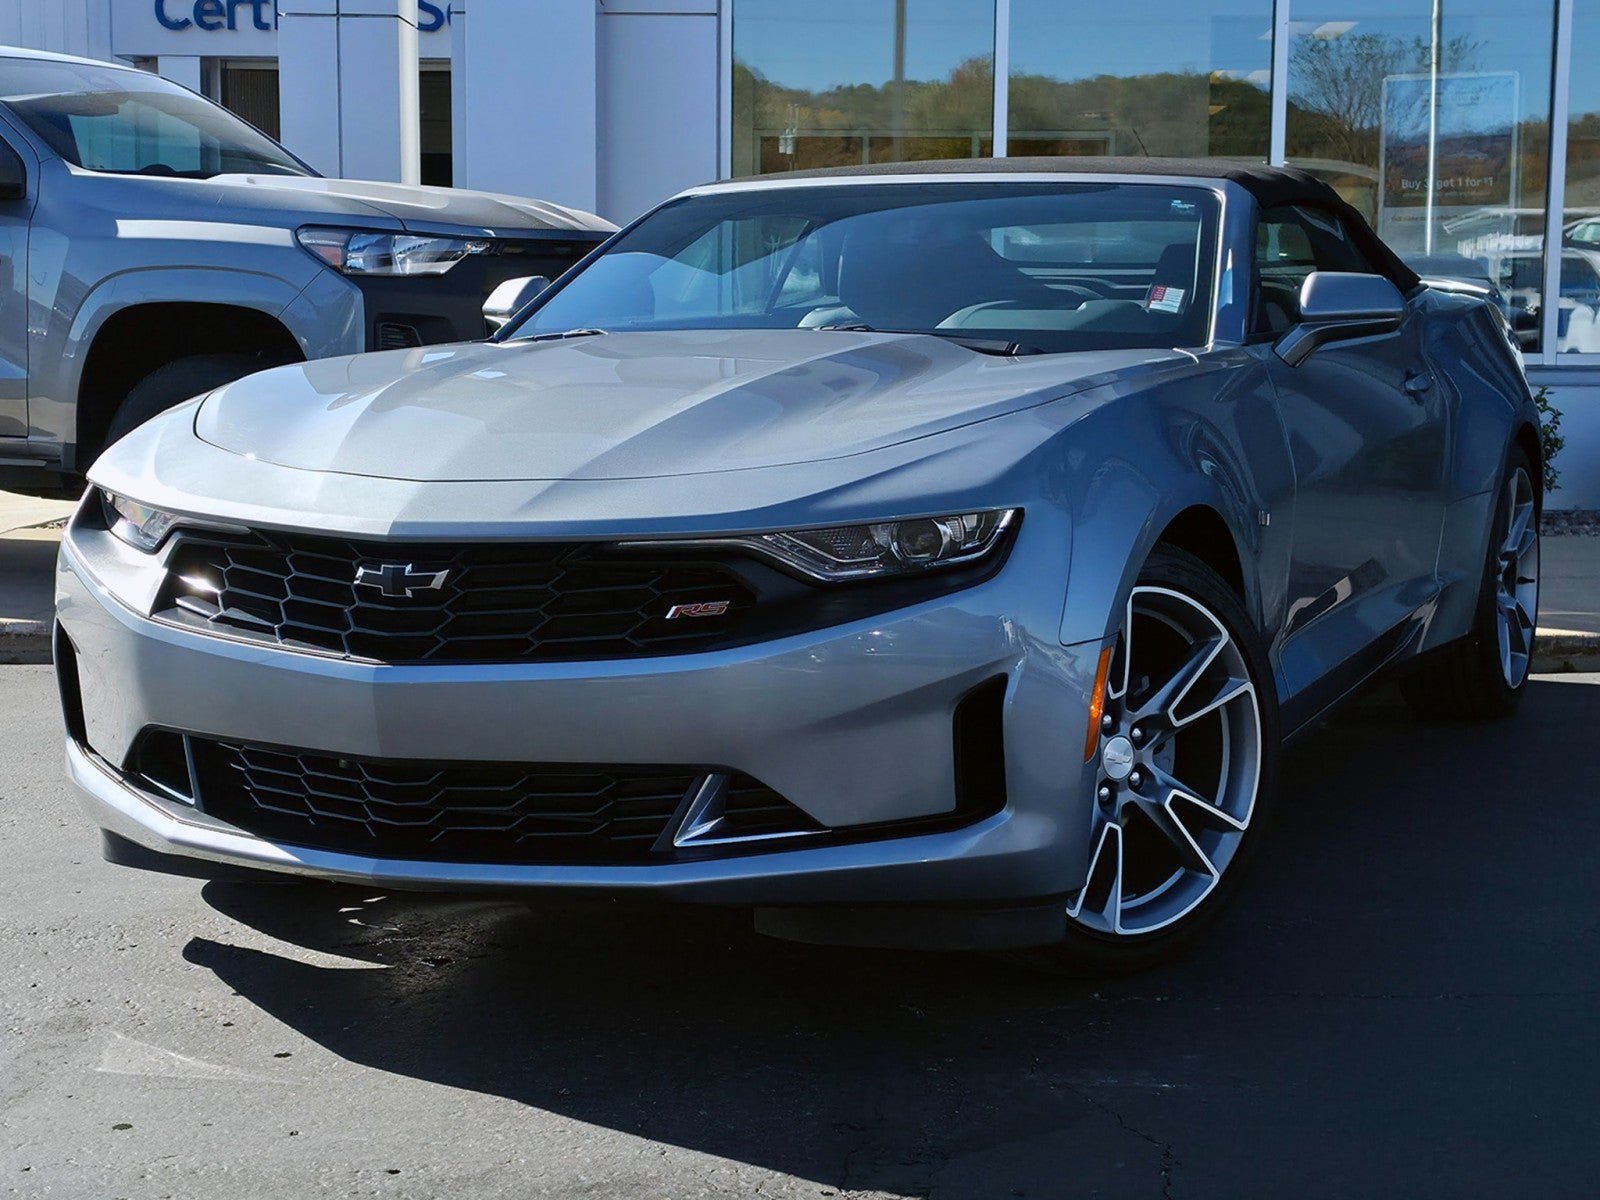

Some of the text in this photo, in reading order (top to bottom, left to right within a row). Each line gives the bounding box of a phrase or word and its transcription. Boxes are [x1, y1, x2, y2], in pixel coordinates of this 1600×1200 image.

[155, 0, 451, 32] Cert S
[1401, 179, 1421, 190] Buy
[1436, 178, 1454, 190] get
[1465, 177, 1481, 187] for
[665, 601, 729, 619] RS
